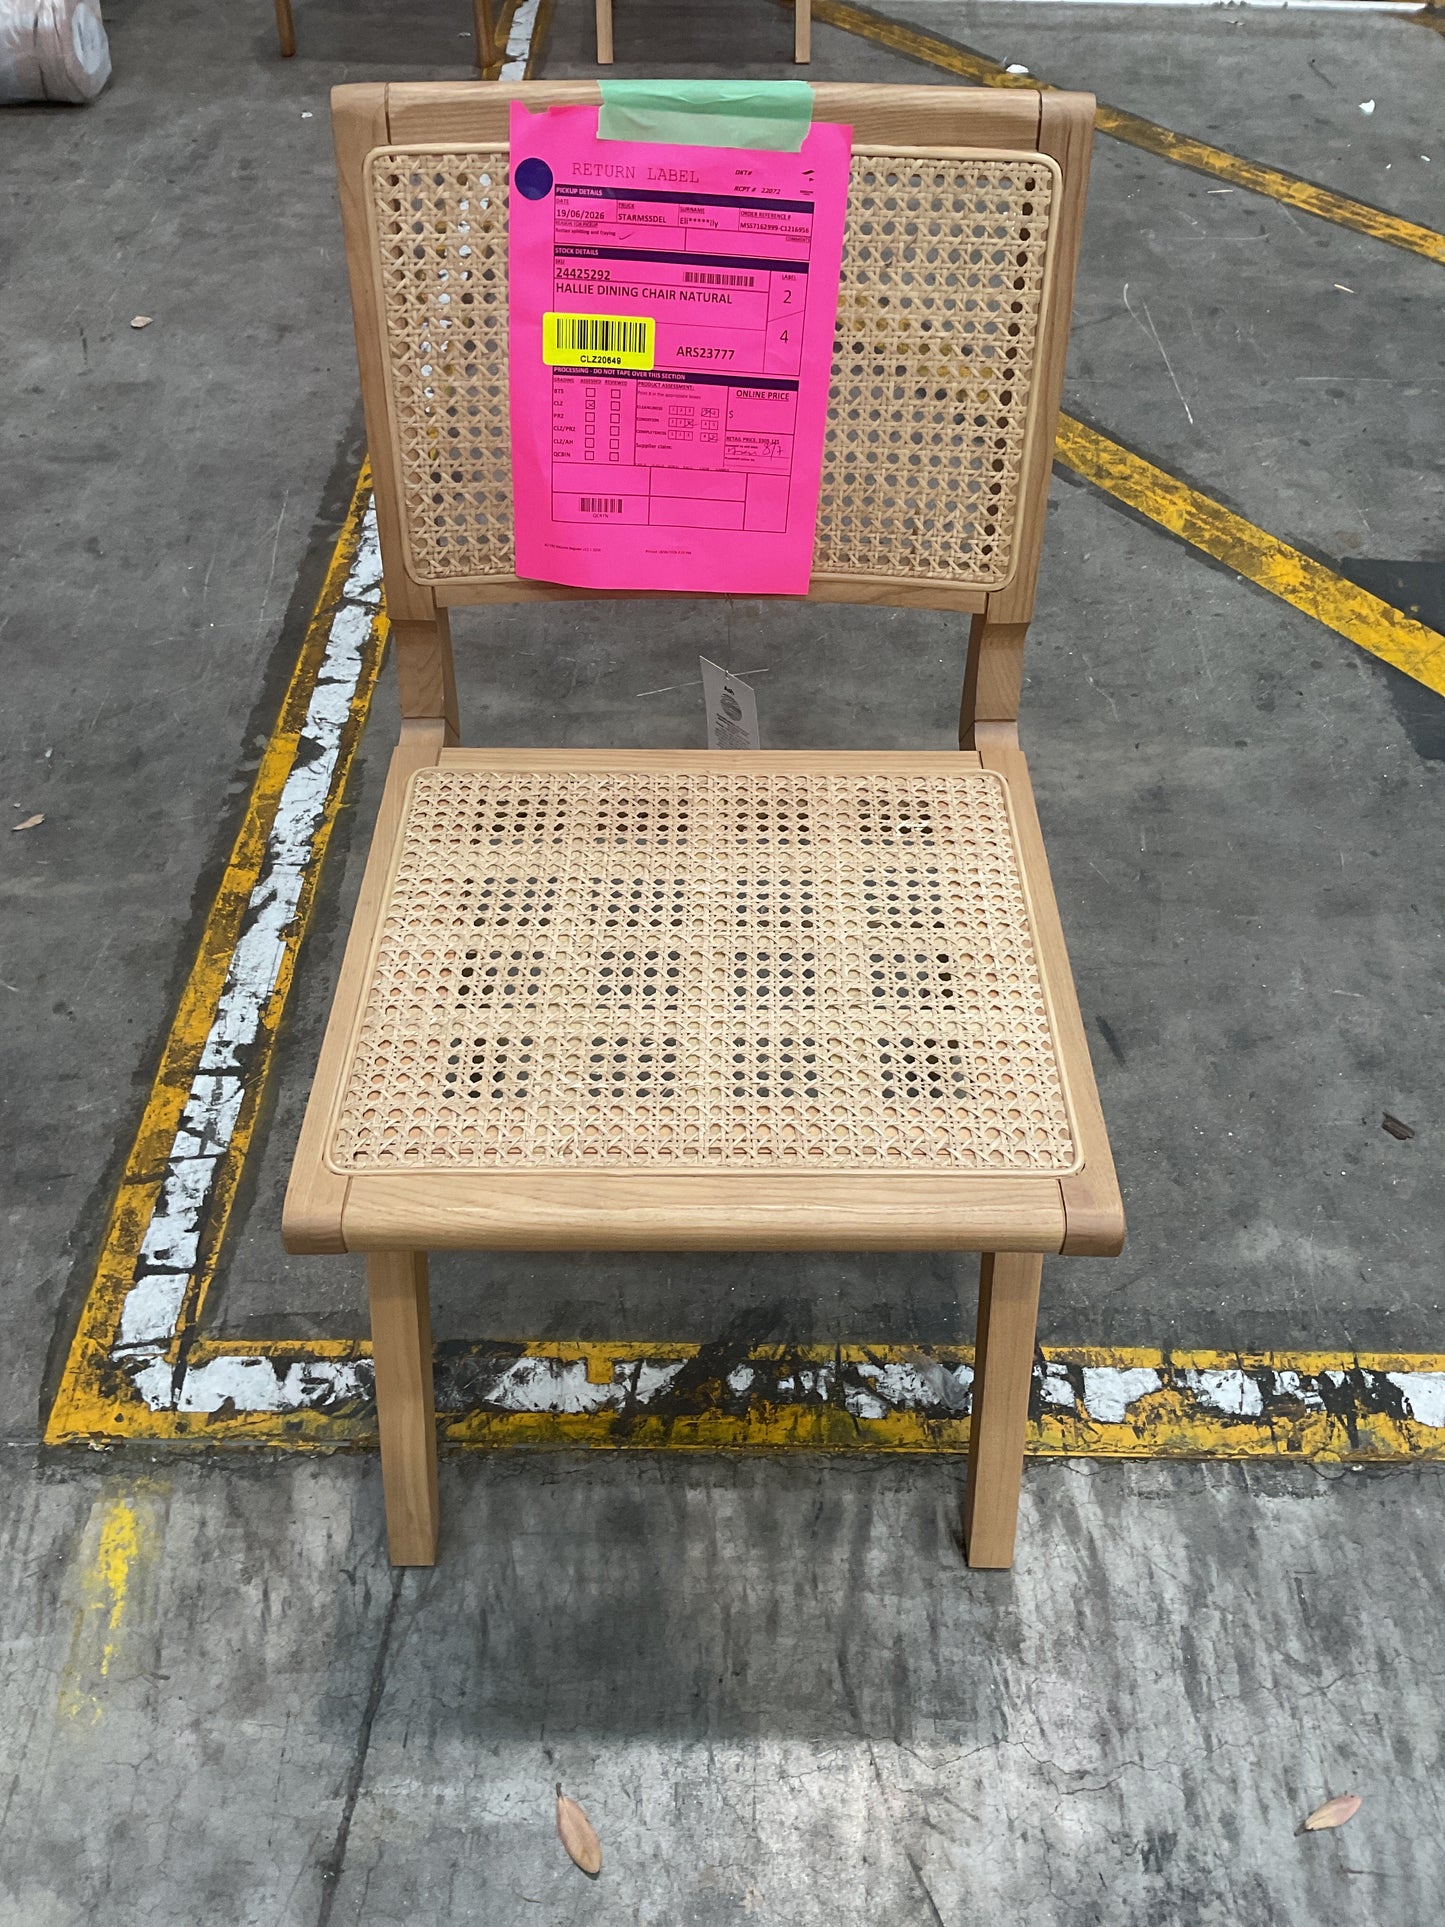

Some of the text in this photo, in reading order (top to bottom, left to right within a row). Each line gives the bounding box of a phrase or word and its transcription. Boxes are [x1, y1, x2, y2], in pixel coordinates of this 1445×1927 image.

[571, 162, 700, 183] RETURN LABEL
[579, 188, 603, 196] DETAILS
[761, 187, 781, 195] 22072
[556, 209, 605, 220] 19/06/2026
[575, 248, 599, 256] DETAILS
[556, 267, 611, 280] 24425292
[556, 283, 733, 304] HALLIE DINING CHAIR NATURAL
[783, 290, 792, 304] 2
[780, 330, 789, 344] 4
[676, 346, 735, 360] ARS23777
[580, 355, 622, 364] CLZ20649
[736, 390, 789, 400] ONLINE PRICE
[728, 410, 734, 419] $
